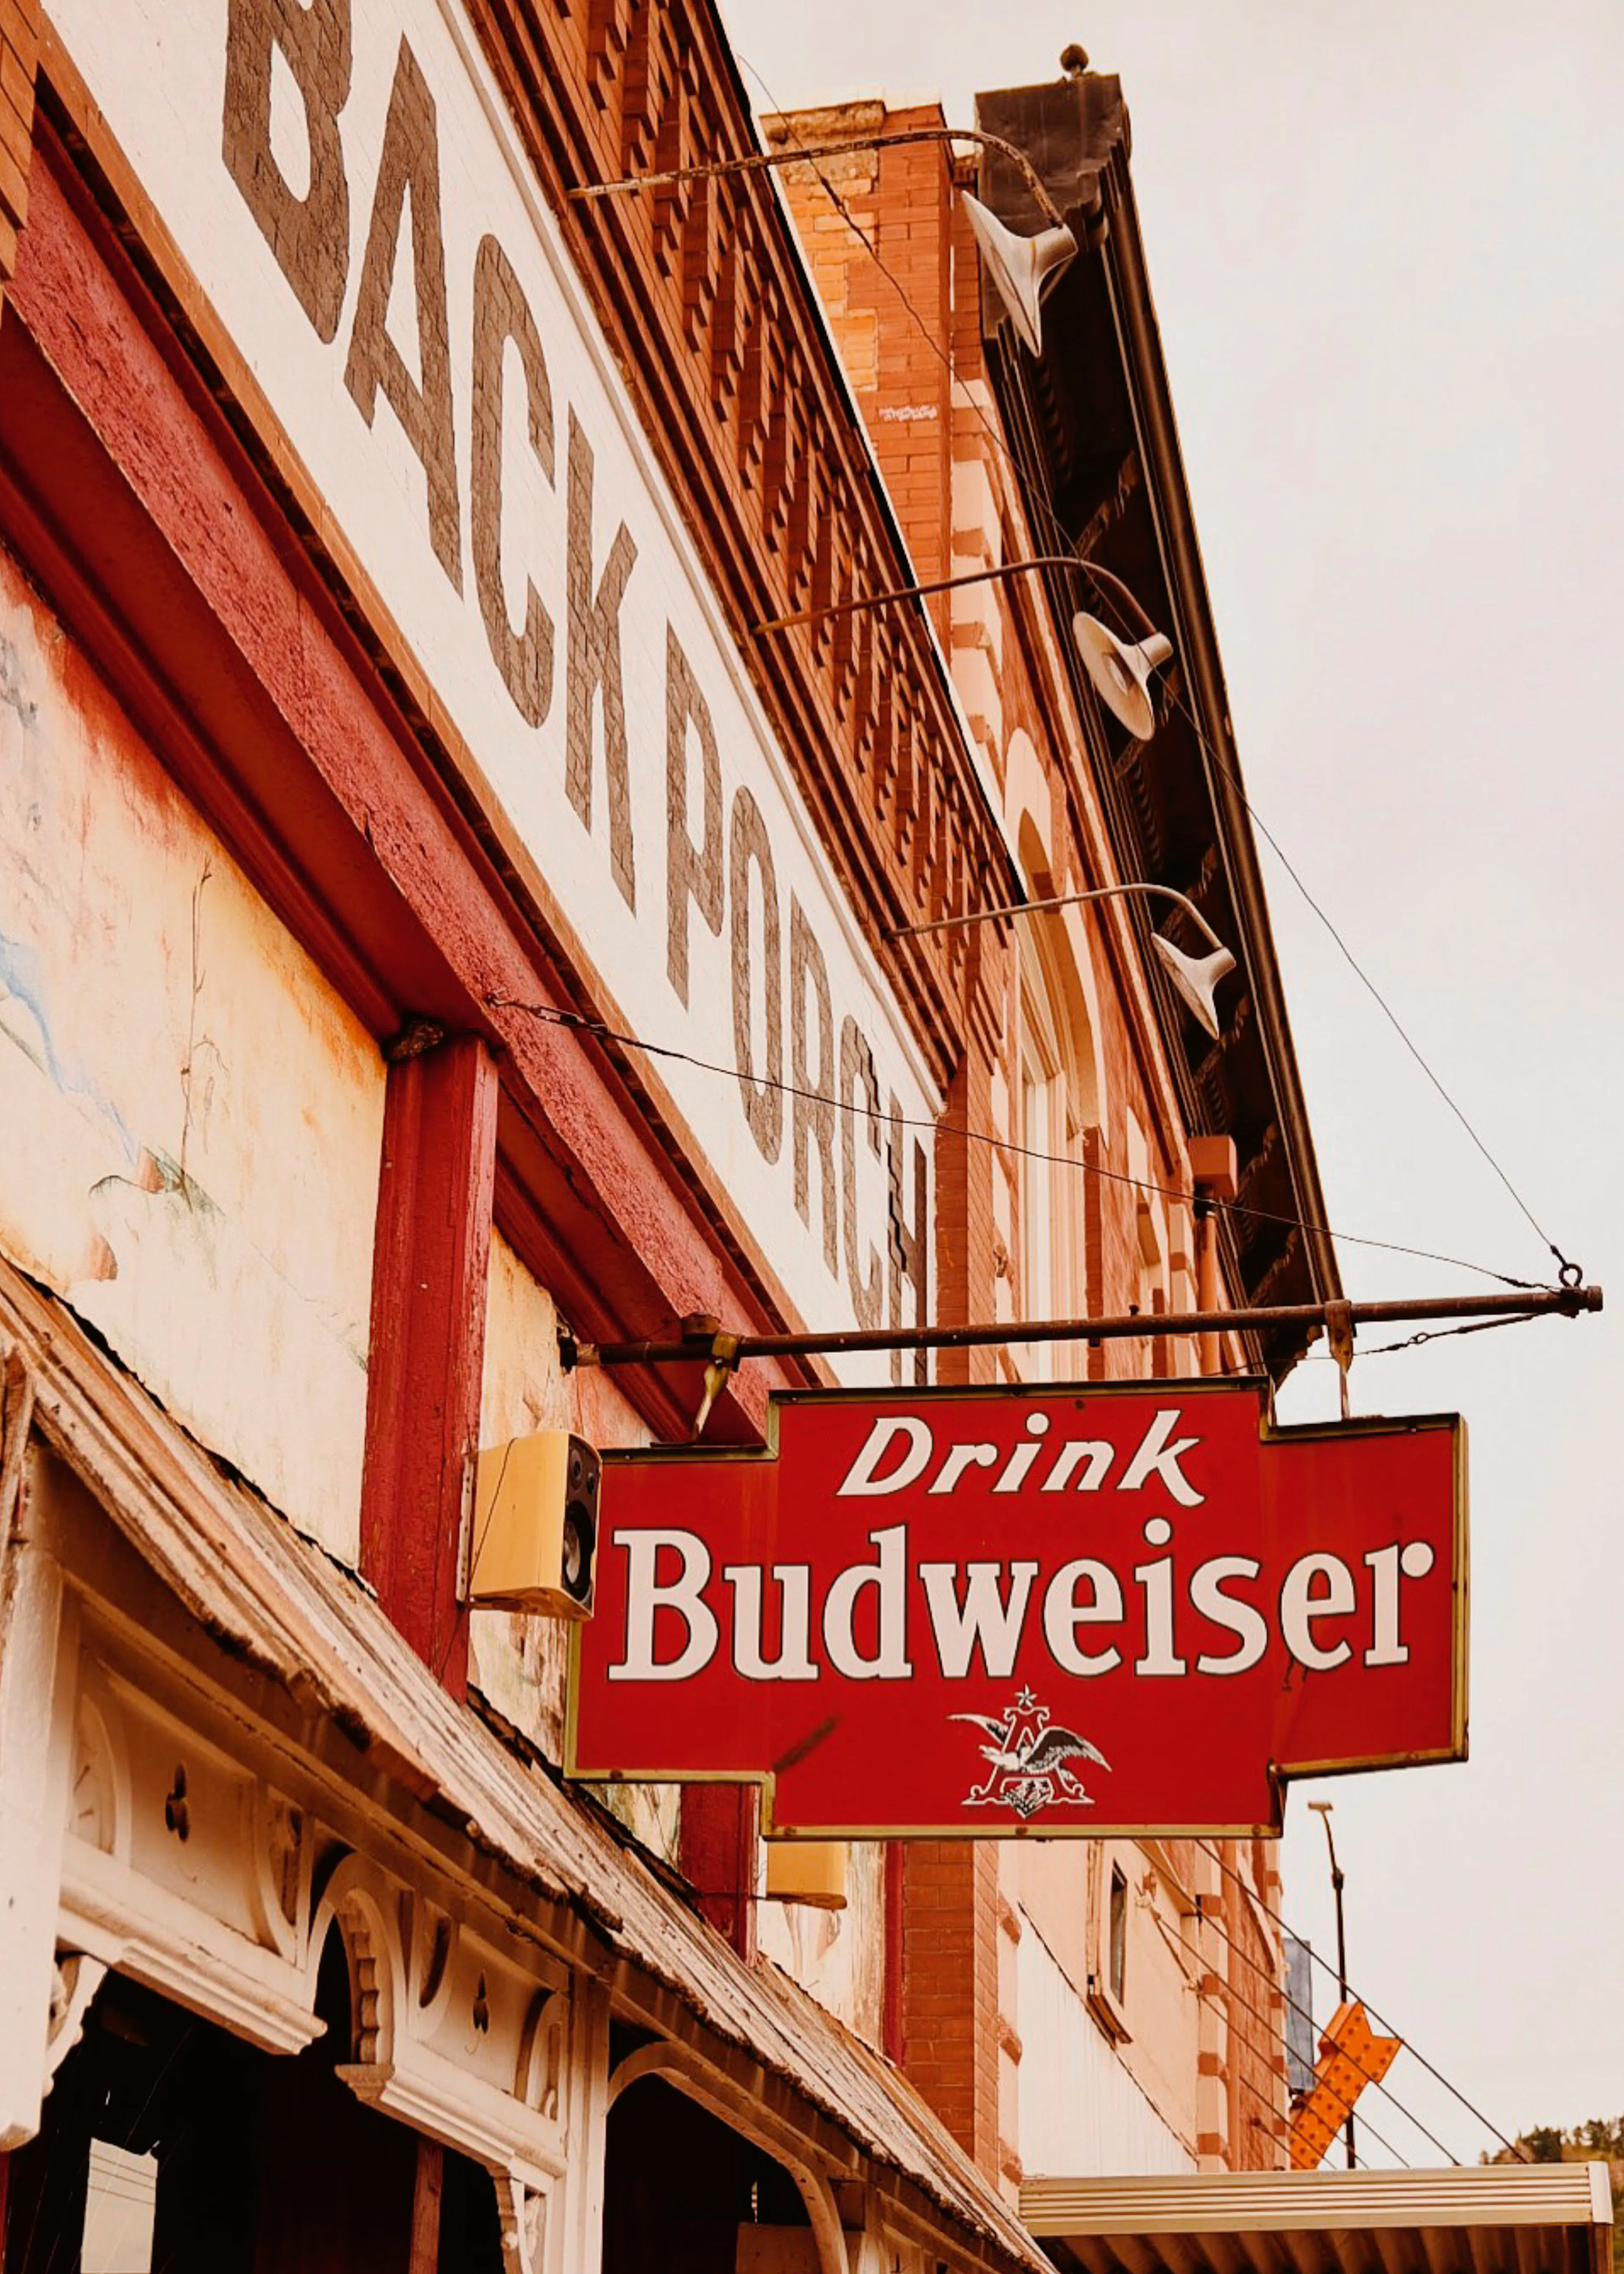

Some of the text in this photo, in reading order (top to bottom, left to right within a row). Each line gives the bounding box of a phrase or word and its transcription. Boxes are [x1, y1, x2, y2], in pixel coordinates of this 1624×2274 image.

[222, 0, 927, 1387] BACK PORCH
[836, 1409, 1205, 1507] Drink
[608, 1519, 1434, 1680] Budweiser
